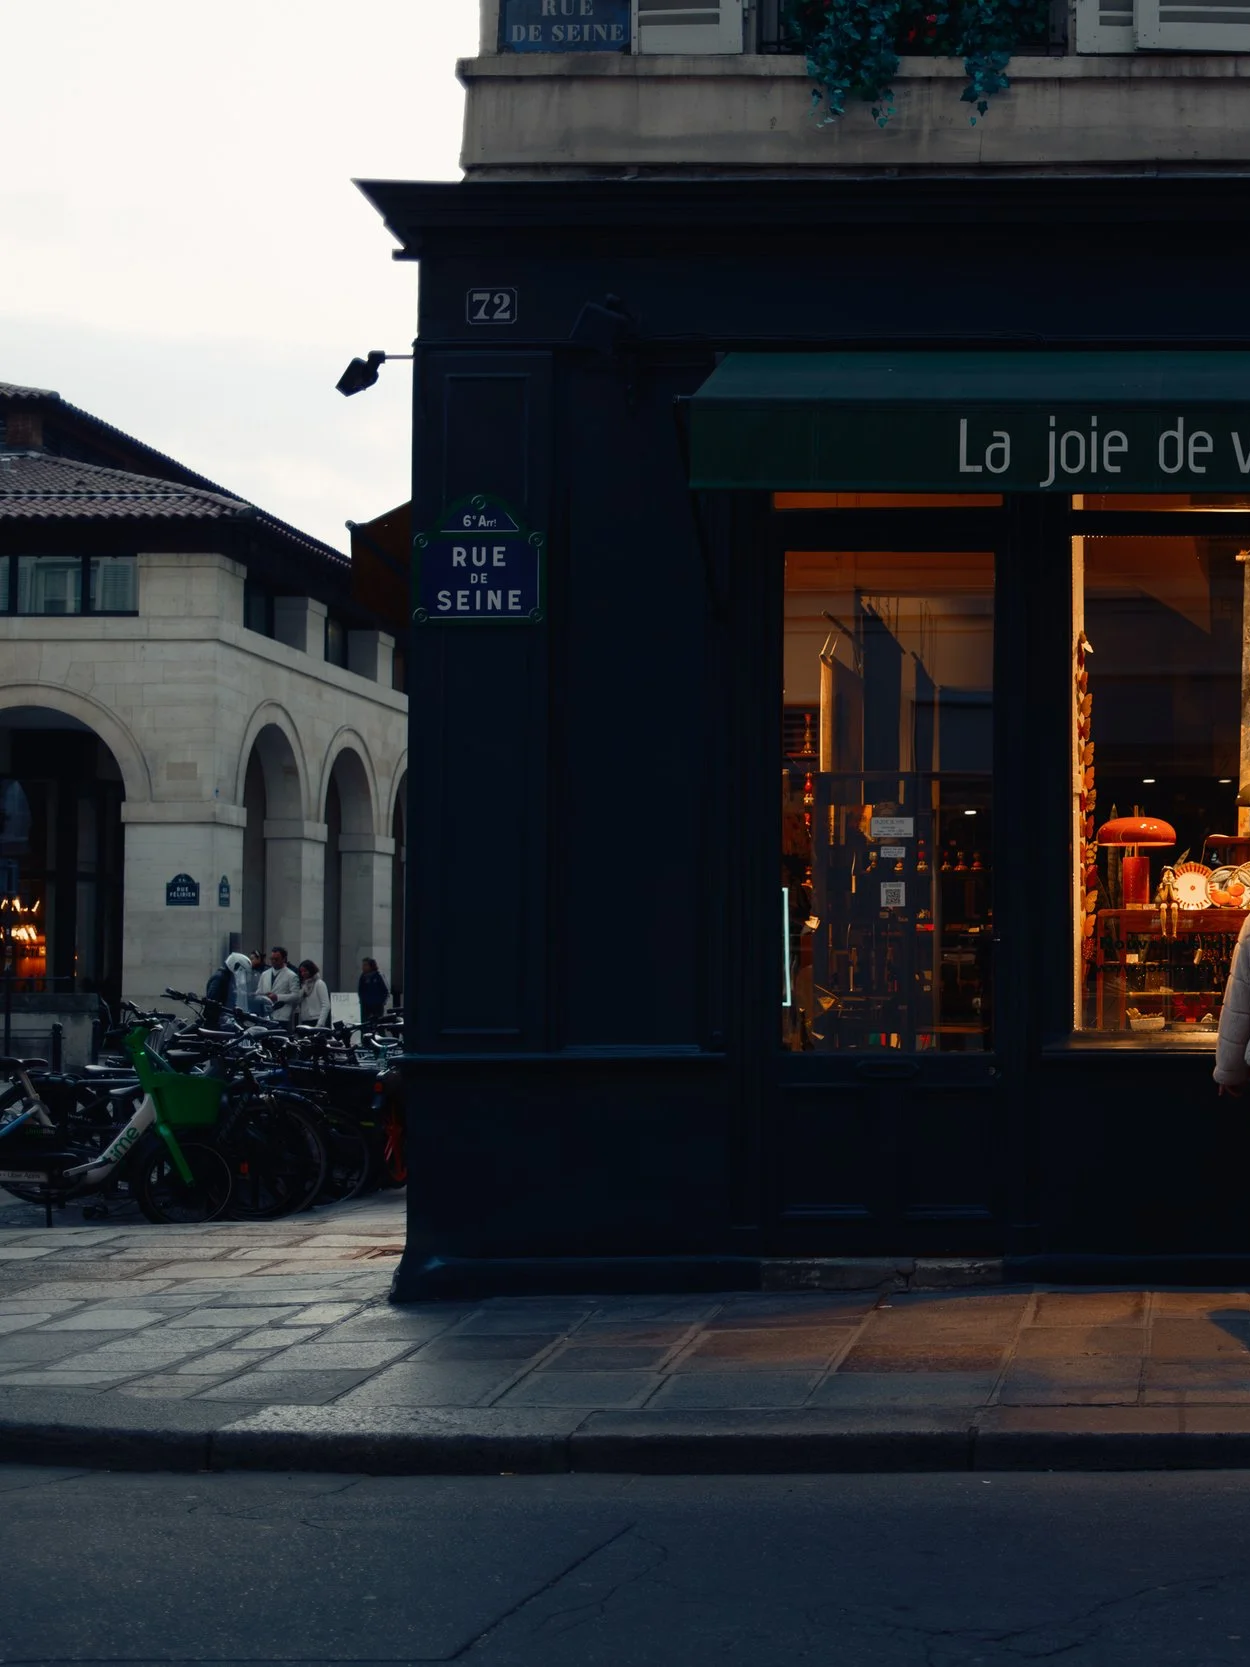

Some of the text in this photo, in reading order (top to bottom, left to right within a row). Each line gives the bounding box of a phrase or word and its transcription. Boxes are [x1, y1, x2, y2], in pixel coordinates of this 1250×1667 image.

[541, 0, 594, 16] RUE
[511, 24, 624, 42] DE SEINE
[472, 292, 511, 320] 72
[958, 418, 1011, 474] La
[1039, 415, 1129, 488] joie
[1158, 416, 1214, 474] de
[452, 546, 507, 567] RUE
[470, 573, 488, 584] DE
[437, 590, 522, 611] SEINE
